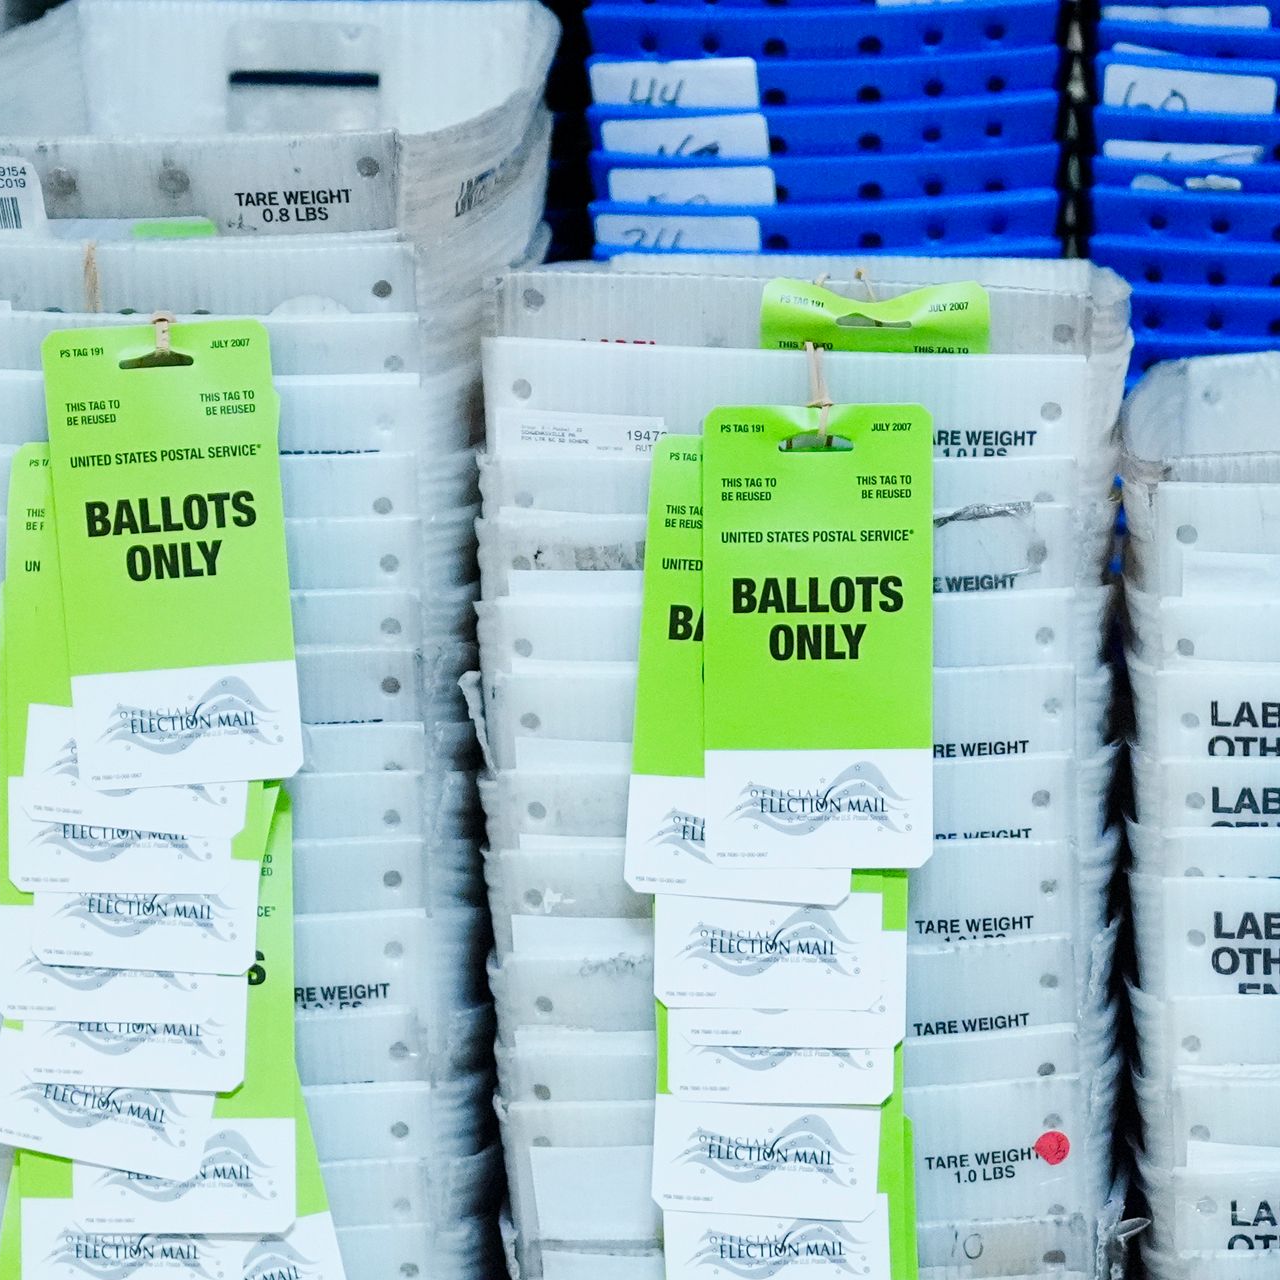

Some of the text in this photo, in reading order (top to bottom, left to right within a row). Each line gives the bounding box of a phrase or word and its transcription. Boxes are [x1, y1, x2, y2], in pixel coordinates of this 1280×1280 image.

[235, 189, 349, 206] TARE WEIGHT
[263, 207, 328, 222] 0.8 LBS
[70, 454, 111, 468] UNITED
[115, 451, 157, 465] STATES
[161, 448, 204, 461] POSTAL
[86, 491, 256, 537] BALLOTS
[722, 532, 763, 543] UNITED
[767, 531, 809, 543] STATES
[813, 531, 856, 542] POSTAL
[127, 540, 222, 581] ONLY
[733, 576, 903, 613] BALLOTS
[770, 624, 866, 661] ONLY
[760, 791, 889, 813] ELECTION MAIL
[915, 916, 1033, 934] TARE WEIGHT
[925, 1154, 968, 1170] TARE
[954, 1165, 1015, 1185] 1.0 LBS
